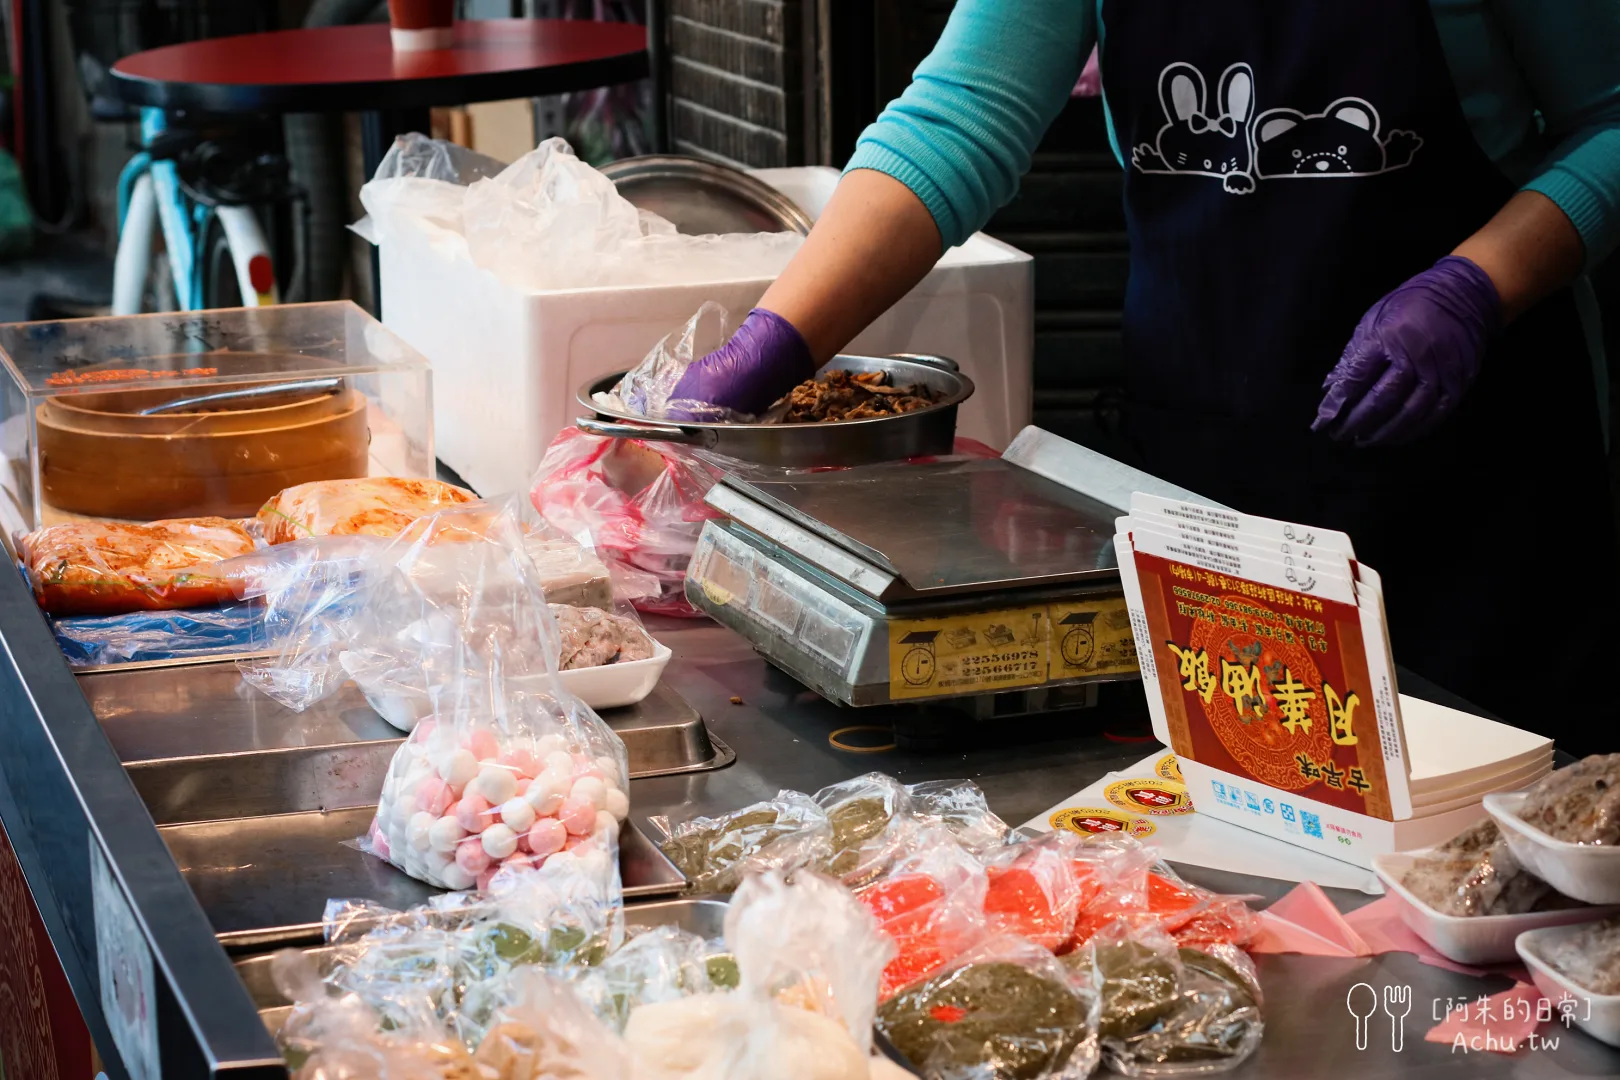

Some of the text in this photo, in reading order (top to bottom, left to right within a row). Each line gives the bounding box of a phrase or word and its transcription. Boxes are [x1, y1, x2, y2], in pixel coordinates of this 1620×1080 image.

[961, 649, 1039, 666] 22556978
[961, 661, 1038, 677] 22566717
[1165, 640, 1360, 746] 月華油飯
[1295, 754, 1371, 794] 古早味
